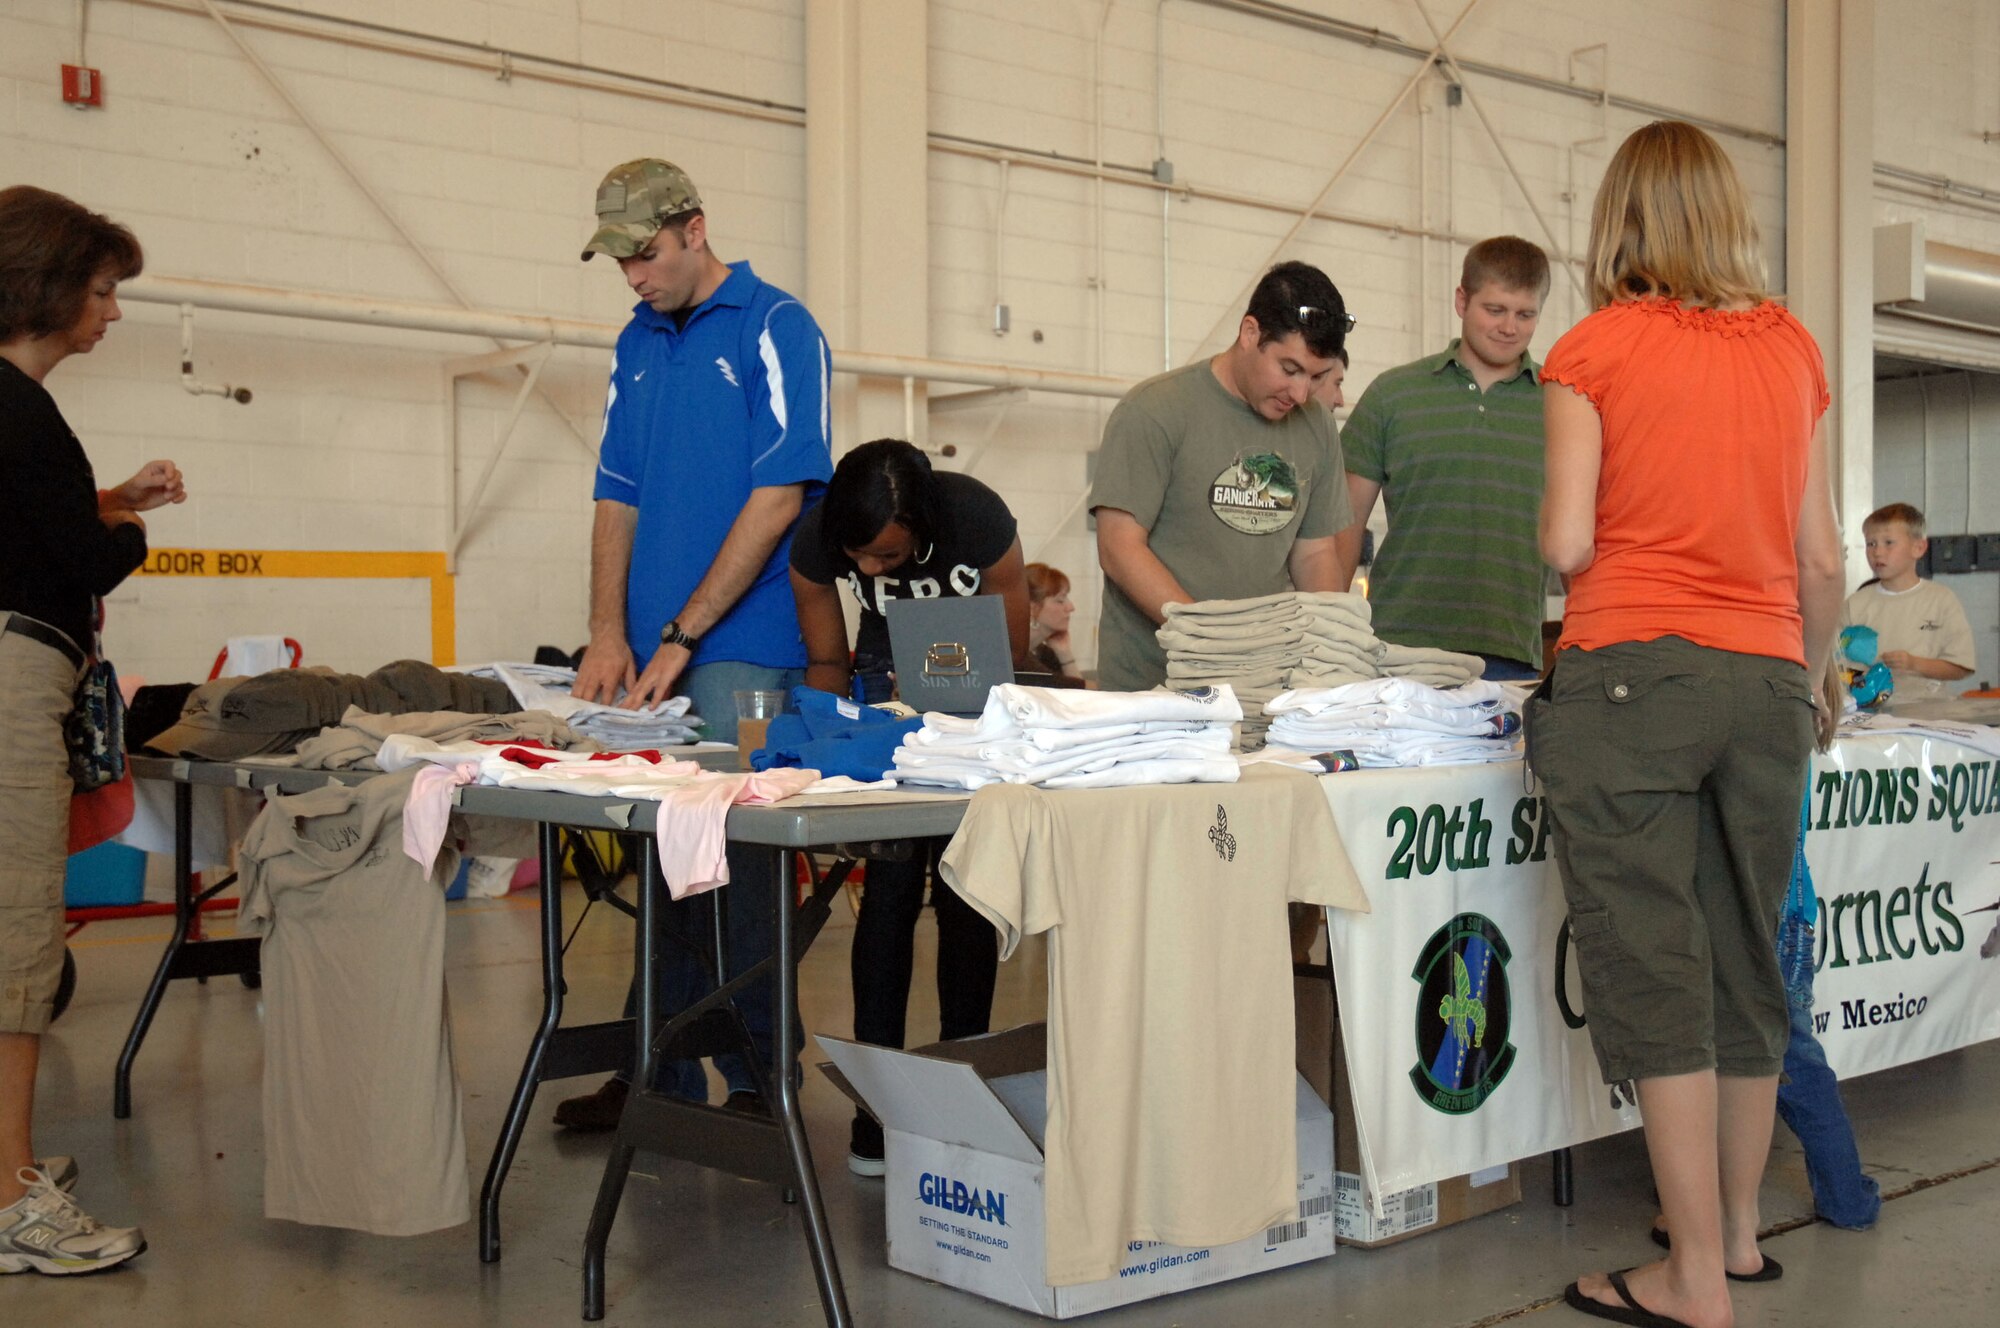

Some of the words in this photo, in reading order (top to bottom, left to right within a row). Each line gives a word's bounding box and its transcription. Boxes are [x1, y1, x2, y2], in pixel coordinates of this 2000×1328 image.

[218, 553, 263, 574] BOX
[1385, 797, 1493, 879] 20th
[1807, 766, 1919, 831] TIONS
[1840, 991, 1928, 1030] Mexico
[918, 1172, 1006, 1226] GILDAN
[919, 1215, 950, 1233] SETTING
[950, 1224, 966, 1237] THE
[967, 1229, 1009, 1250] STANDARD
[935, 1239, 992, 1263] www.gildan.com
[1119, 1249, 1210, 1278] www.gildan.com
